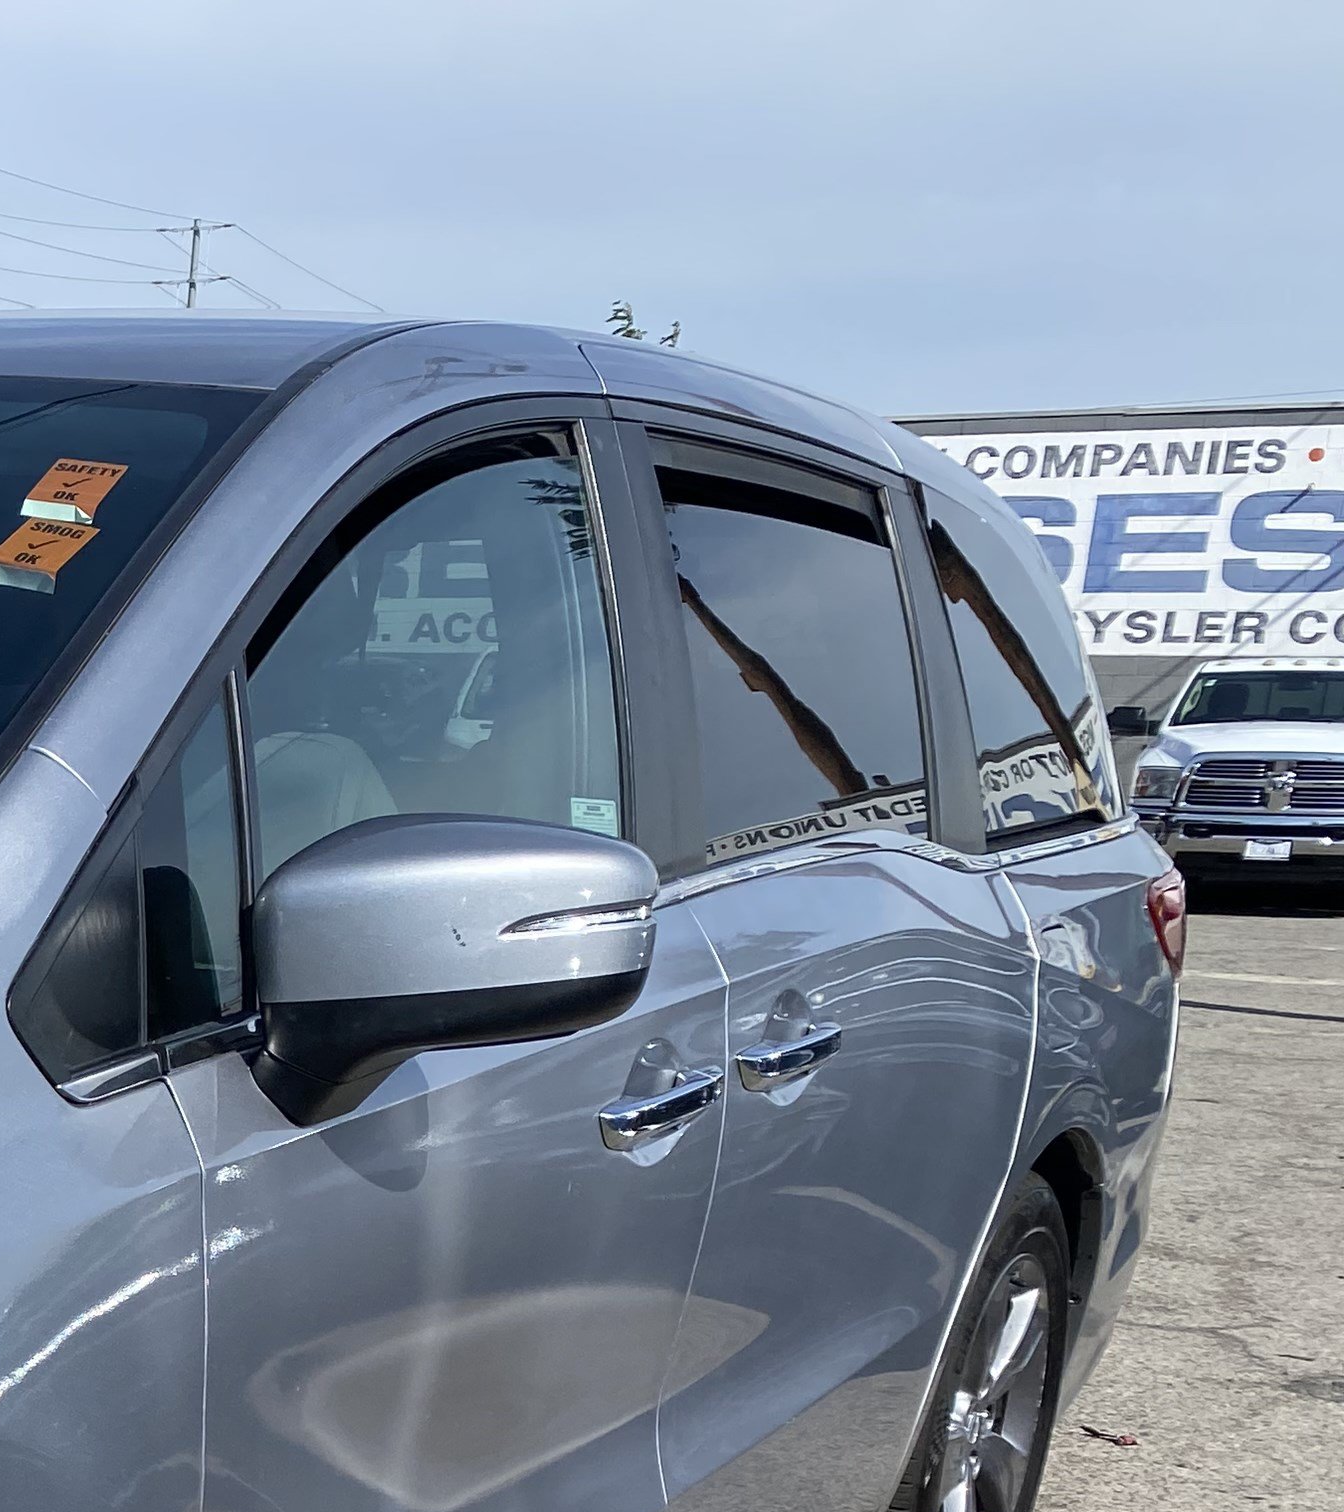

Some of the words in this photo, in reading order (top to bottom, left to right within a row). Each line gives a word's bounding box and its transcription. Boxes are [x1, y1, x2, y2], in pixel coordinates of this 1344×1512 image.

[964, 437, 1288, 481] COMPANIES
[54, 462, 121, 478] SAFETY
[53, 490, 80, 501] OK
[29, 522, 86, 540] SMOG
[14, 552, 41, 565] OK
[1073, 609, 1269, 645] YSLER
